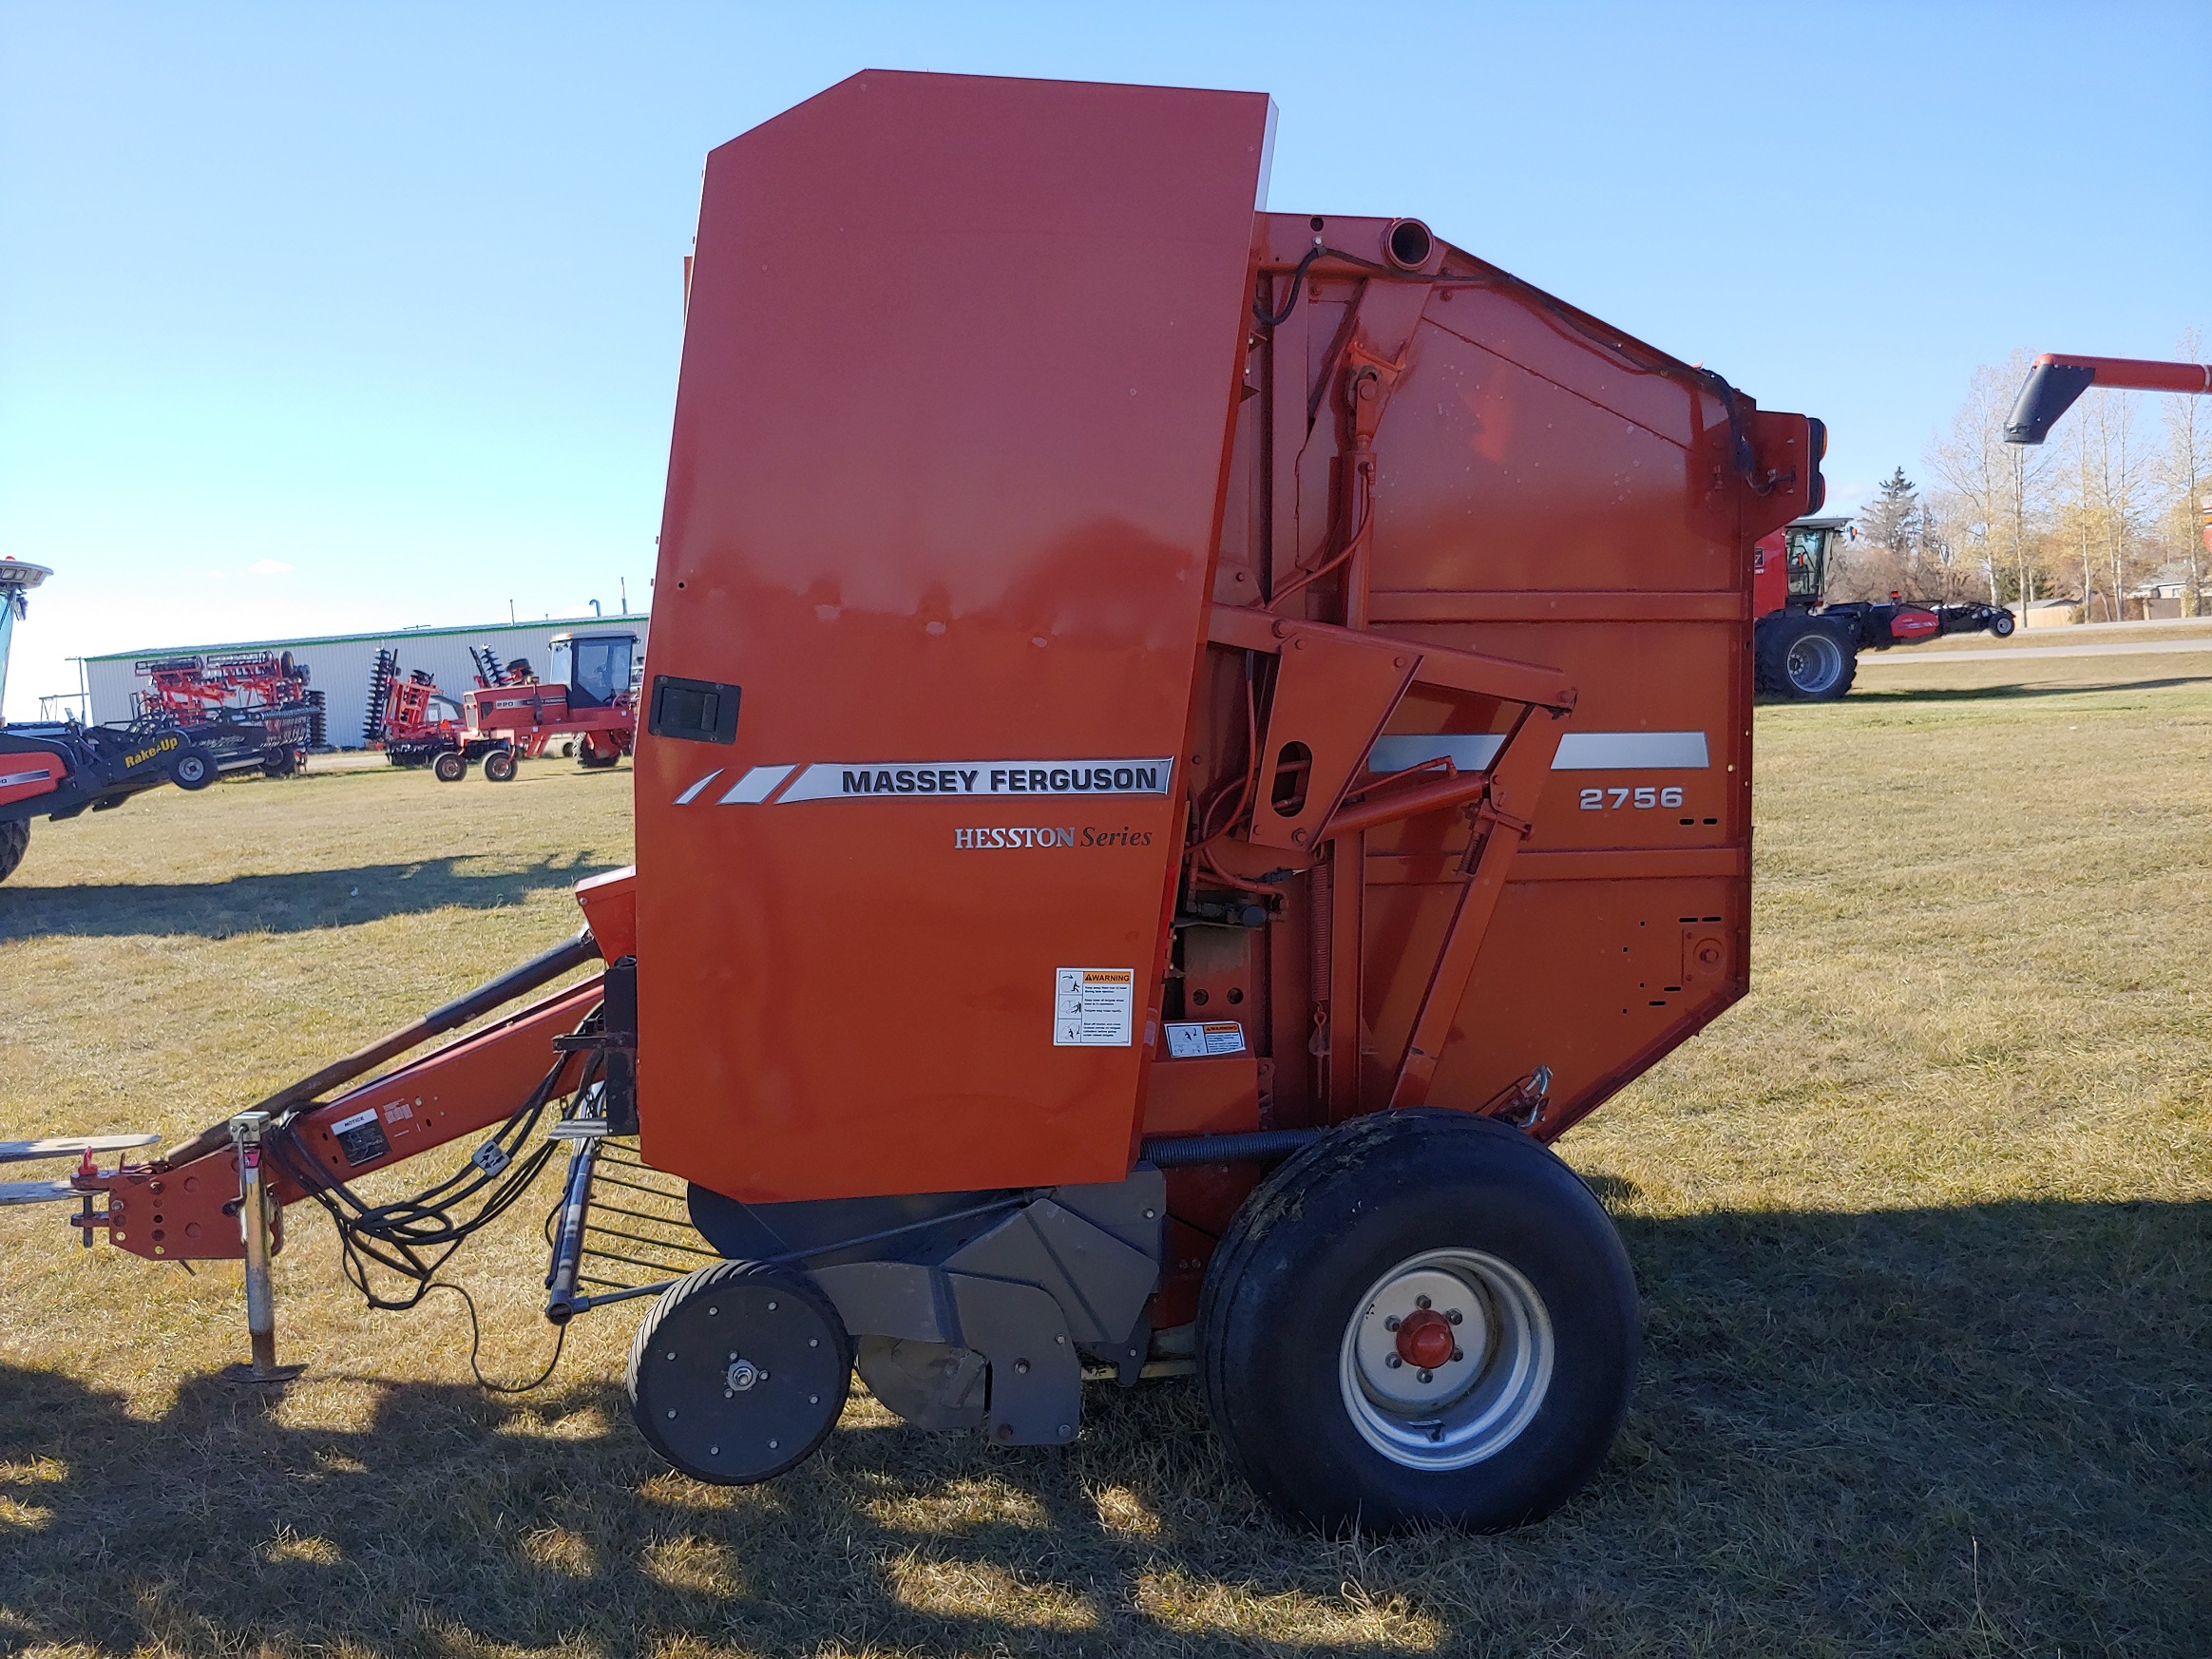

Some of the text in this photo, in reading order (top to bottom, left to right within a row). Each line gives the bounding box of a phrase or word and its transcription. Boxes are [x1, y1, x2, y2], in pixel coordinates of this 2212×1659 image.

[842, 768, 1156, 792] MASSEY FERGUSON
[1579, 787, 1684, 810] 2756
[954, 826, 1153, 849] HESSTON Series
[344, 1116, 365, 1127] NOTICE
